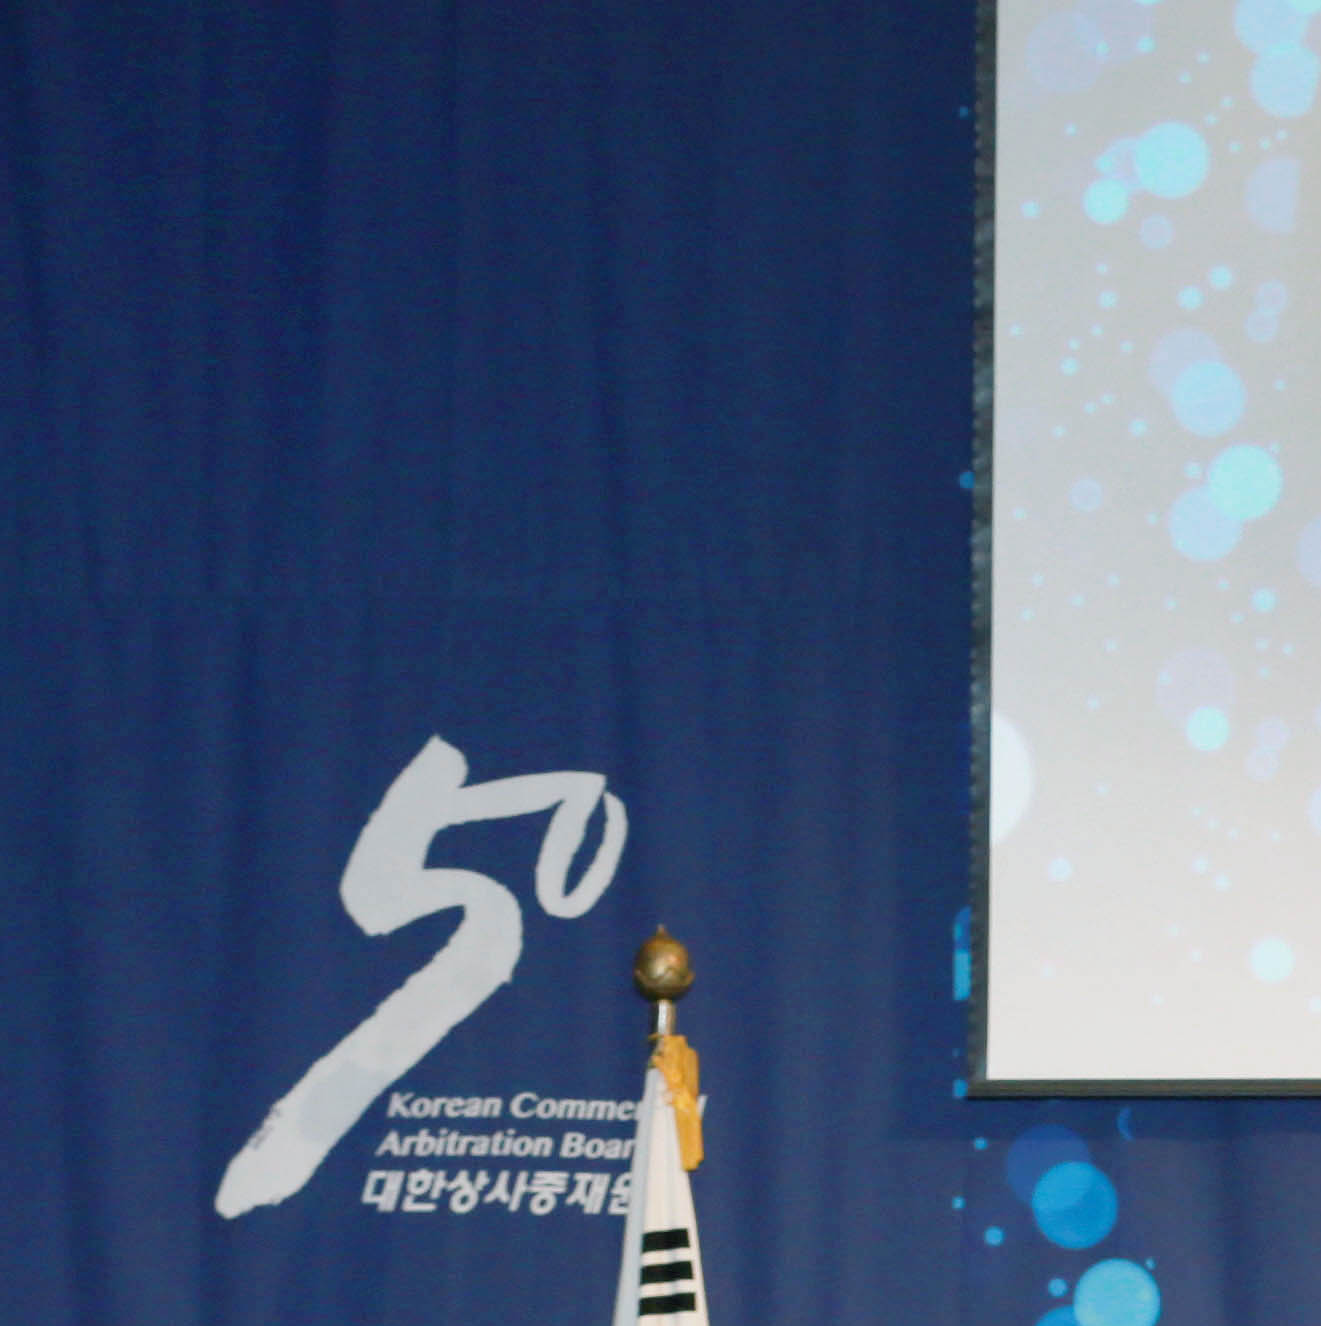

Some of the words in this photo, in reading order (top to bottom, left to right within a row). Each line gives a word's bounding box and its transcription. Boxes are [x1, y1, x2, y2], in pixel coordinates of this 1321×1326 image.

[386, 1091, 503, 1119] Korean
[375, 1128, 552, 1158] Arbitration
[560, 1132, 635, 1159] Boar
